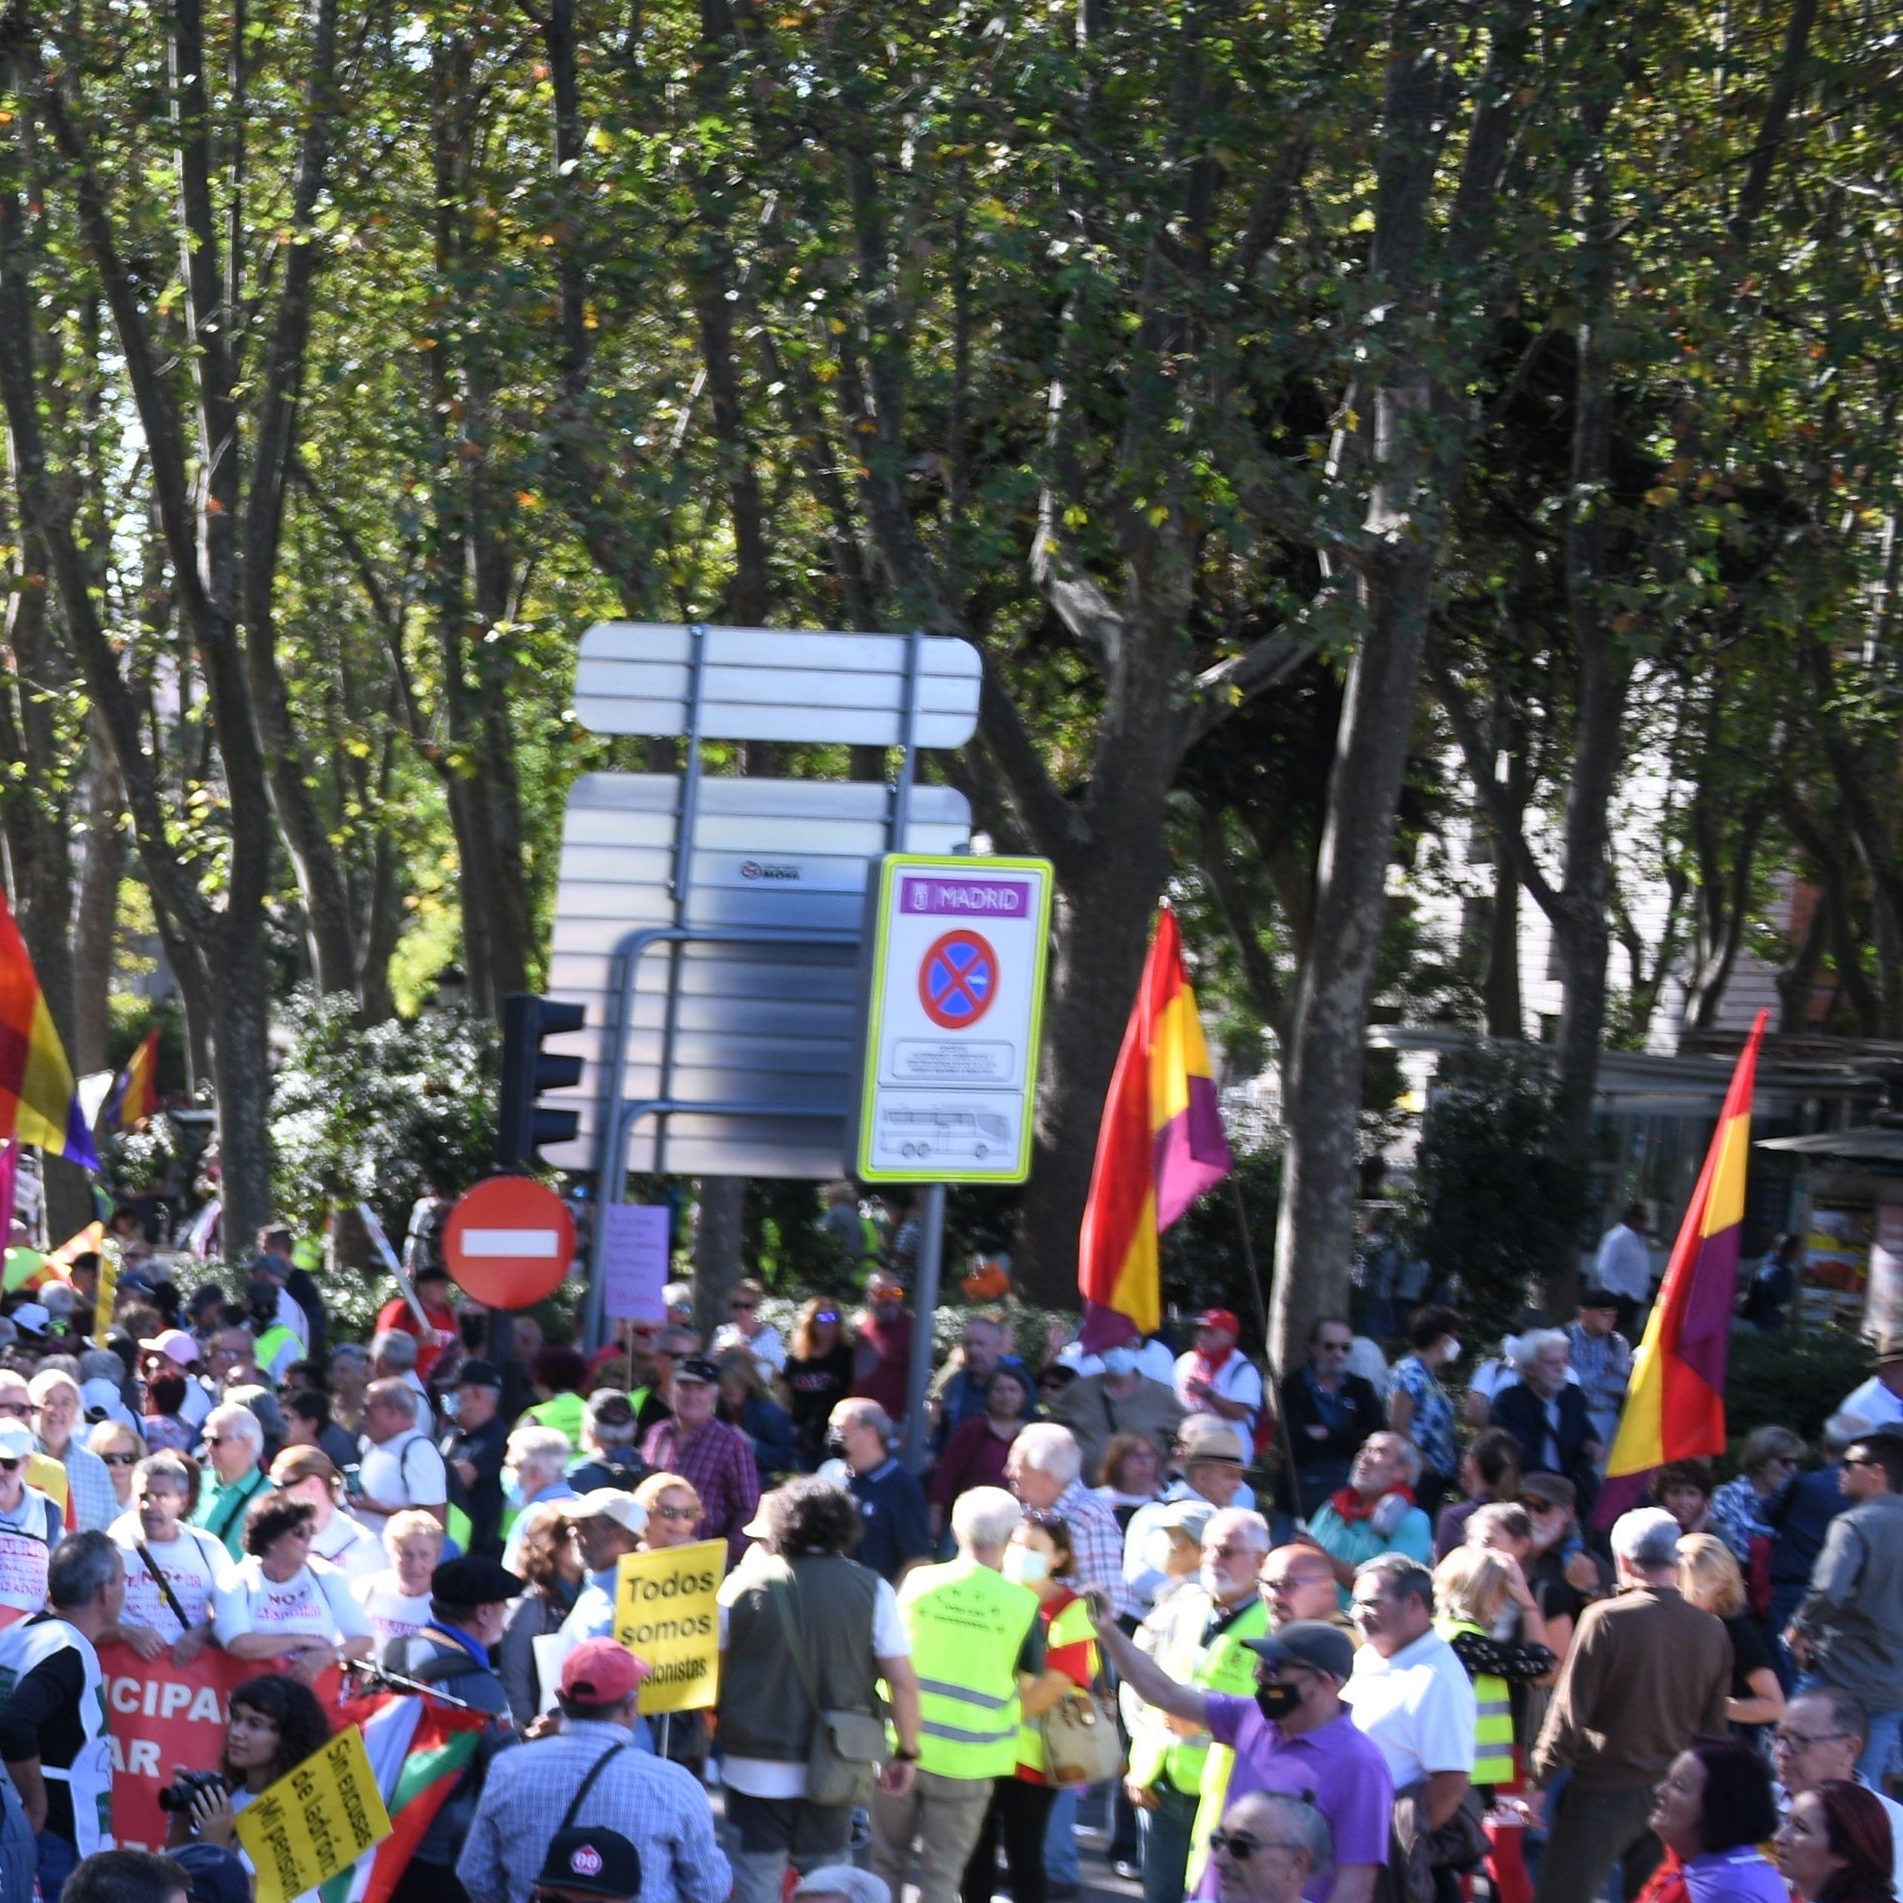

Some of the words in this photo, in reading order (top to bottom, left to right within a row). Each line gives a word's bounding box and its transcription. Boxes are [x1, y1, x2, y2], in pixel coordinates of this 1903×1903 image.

[939, 887, 1019, 910] MADRID
[627, 1570, 714, 1602] Todos
[621, 1614, 712, 1646] somos
